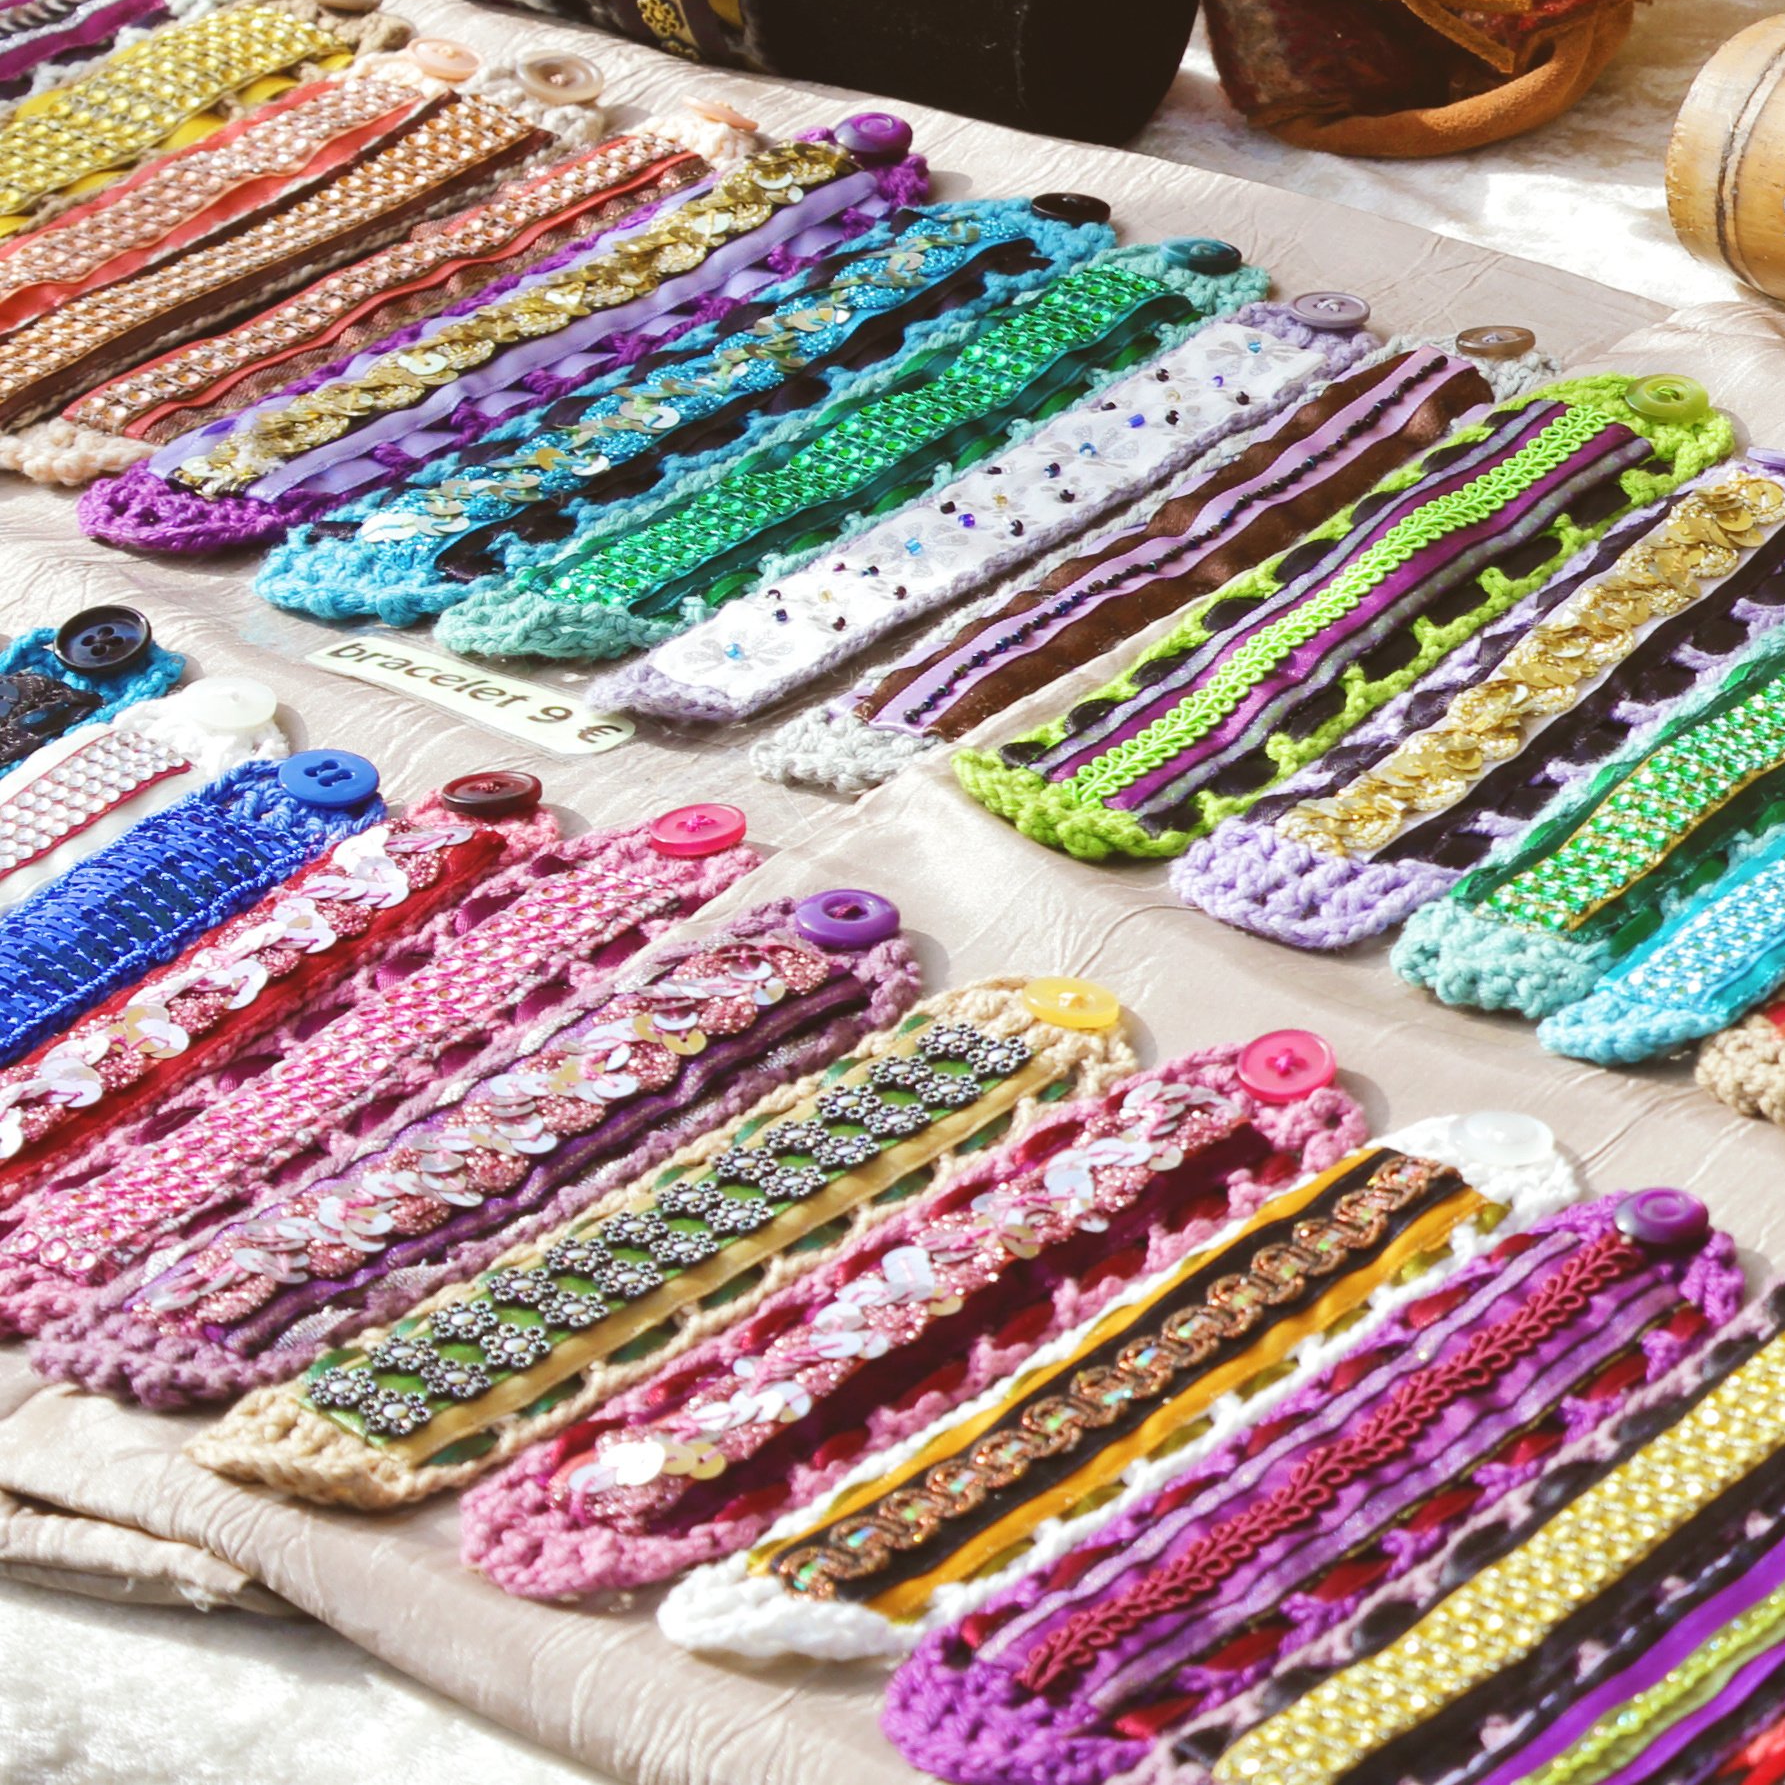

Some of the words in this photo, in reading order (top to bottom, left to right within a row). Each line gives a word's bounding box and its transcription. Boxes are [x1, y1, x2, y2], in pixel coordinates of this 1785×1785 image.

[325, 641, 530, 708] bracelet
[527, 705, 573, 724] 9
[577, 724, 622, 744] €
